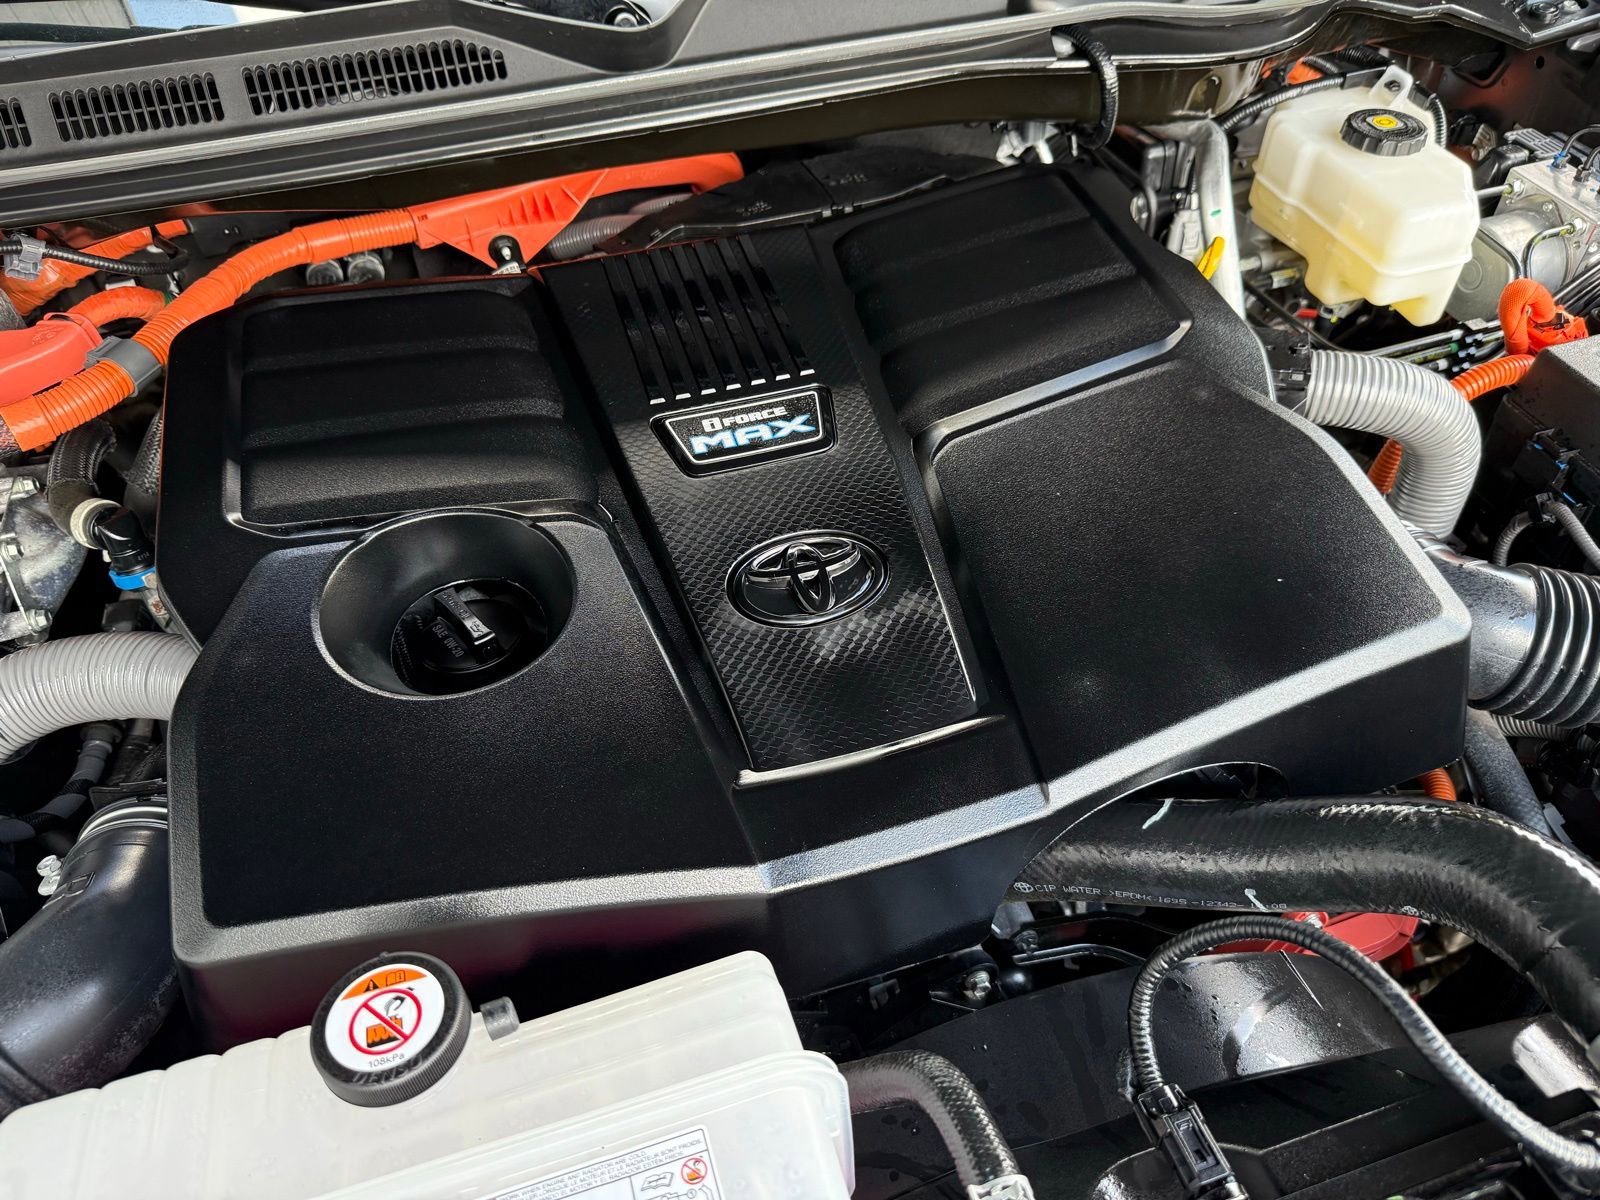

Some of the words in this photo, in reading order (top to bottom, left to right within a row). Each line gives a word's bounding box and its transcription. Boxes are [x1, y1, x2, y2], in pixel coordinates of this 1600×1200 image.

[689, 413, 816, 454] MAX
[431, 622, 447, 639] SAE
[443, 635, 464, 659] 0W-20
[1034, 883, 1056, 892] CIP
[1062, 886, 1101, 894] WATER
[368, 1054, 405, 1068] 108kPa
